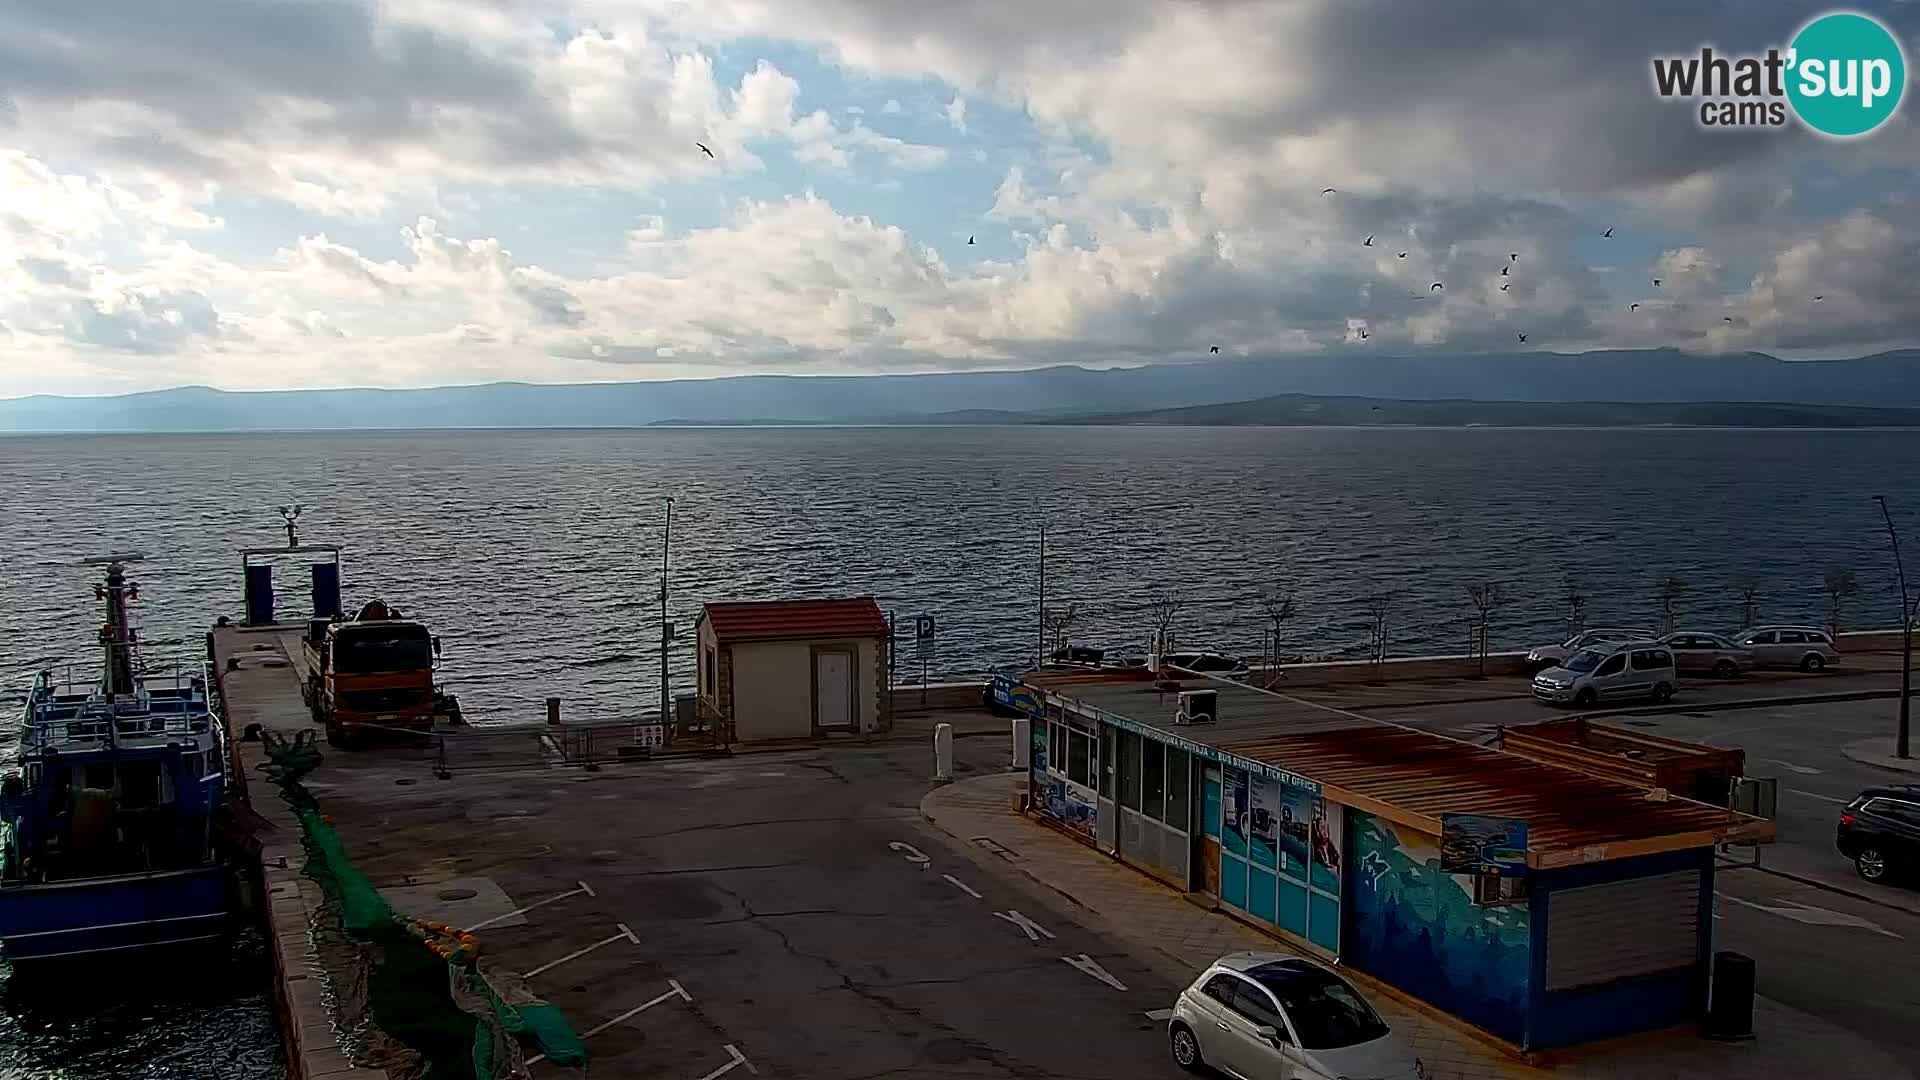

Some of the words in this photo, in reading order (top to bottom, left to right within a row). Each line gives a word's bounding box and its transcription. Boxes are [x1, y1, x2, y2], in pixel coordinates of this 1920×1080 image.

[921, 620, 930, 635] P
[1233, 757, 1263, 775] STATION
[1266, 767, 1290, 783] TICKET
[1291, 776, 1317, 792] OFFICE
